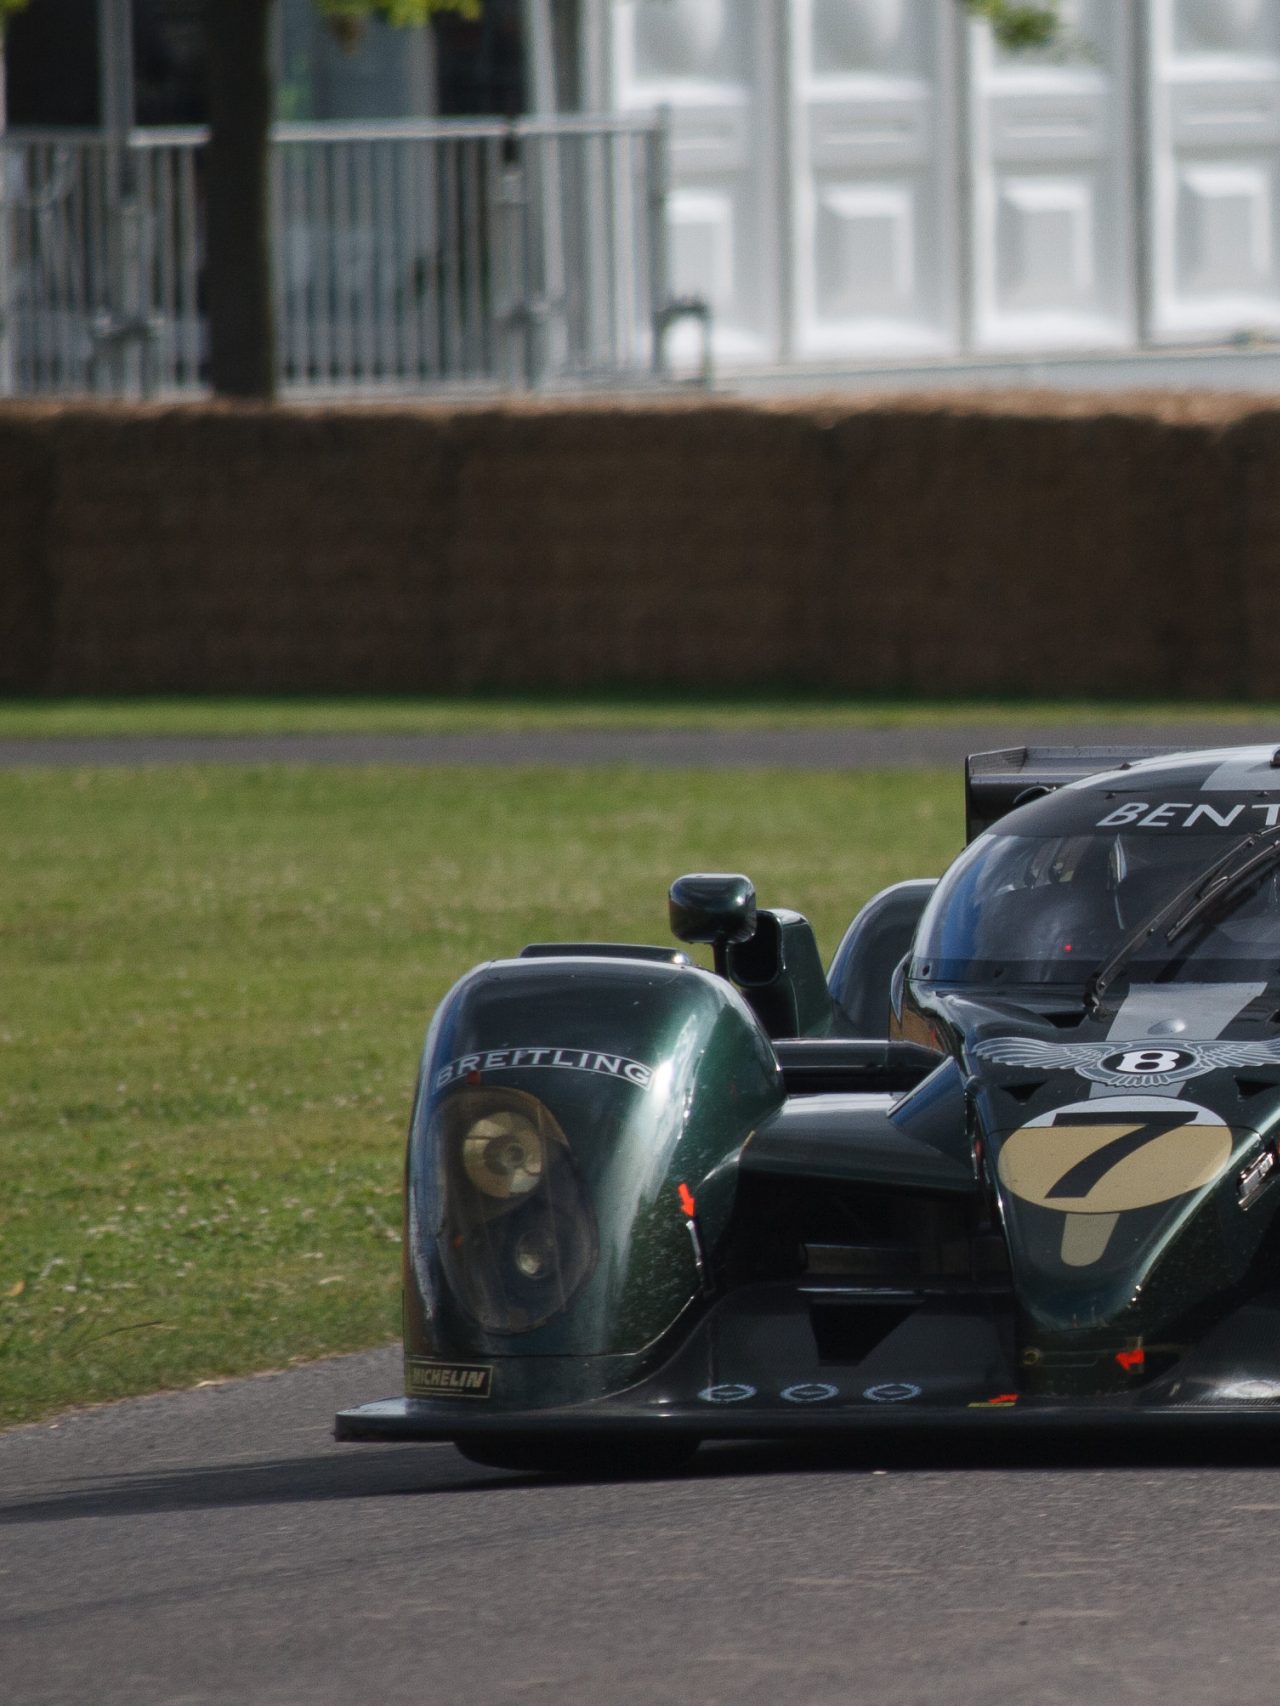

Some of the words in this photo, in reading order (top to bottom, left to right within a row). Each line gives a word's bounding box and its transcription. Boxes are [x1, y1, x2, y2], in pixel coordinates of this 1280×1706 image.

[435, 1049, 652, 1089] BREITLING
[1117, 1050, 1180, 1073] B
[1045, 1111, 1198, 1198] 7
[412, 1368, 486, 1388] MICHELIN
